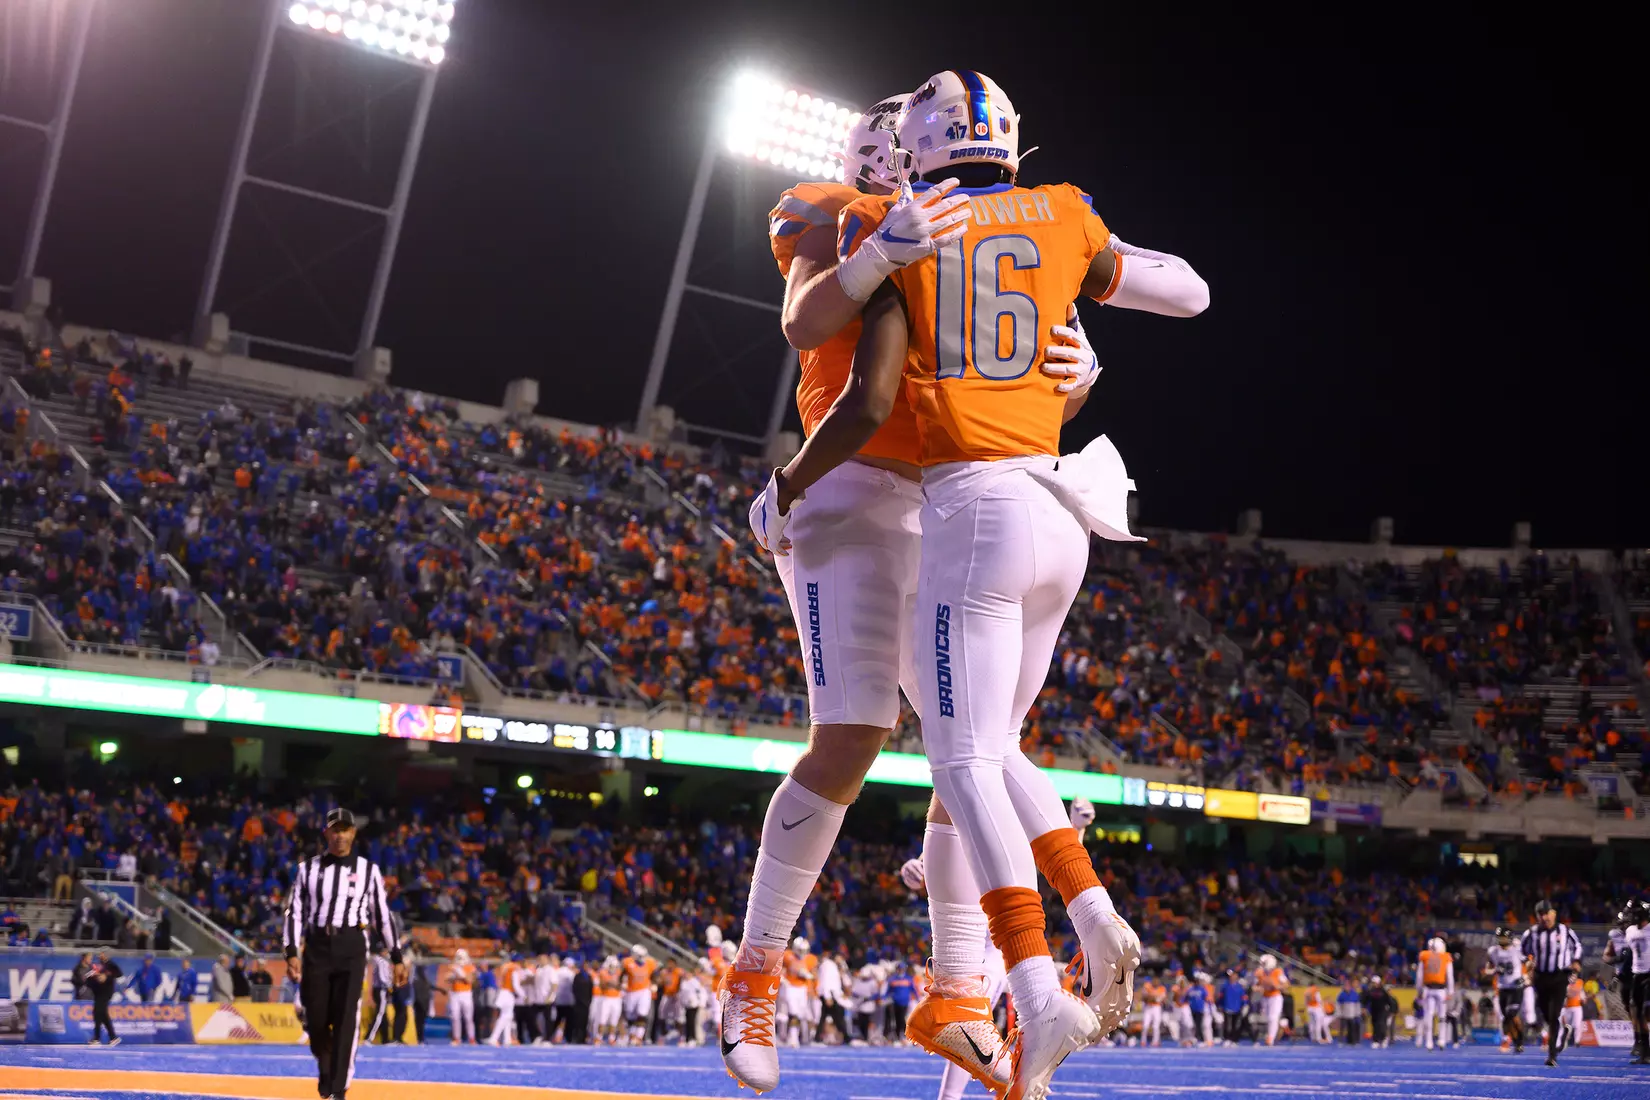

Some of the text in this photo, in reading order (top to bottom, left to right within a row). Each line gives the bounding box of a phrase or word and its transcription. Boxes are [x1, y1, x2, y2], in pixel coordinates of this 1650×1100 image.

[976, 125, 987, 135] 16
[949, 146, 1010, 161] BRONCOS
[962, 192, 1055, 227] OWER
[935, 233, 1041, 381] 16
[806, 580, 826, 687] BRONCOS
[935, 602, 955, 719] BRONCOS
[68, 1003, 187, 1021] GORONCOS
